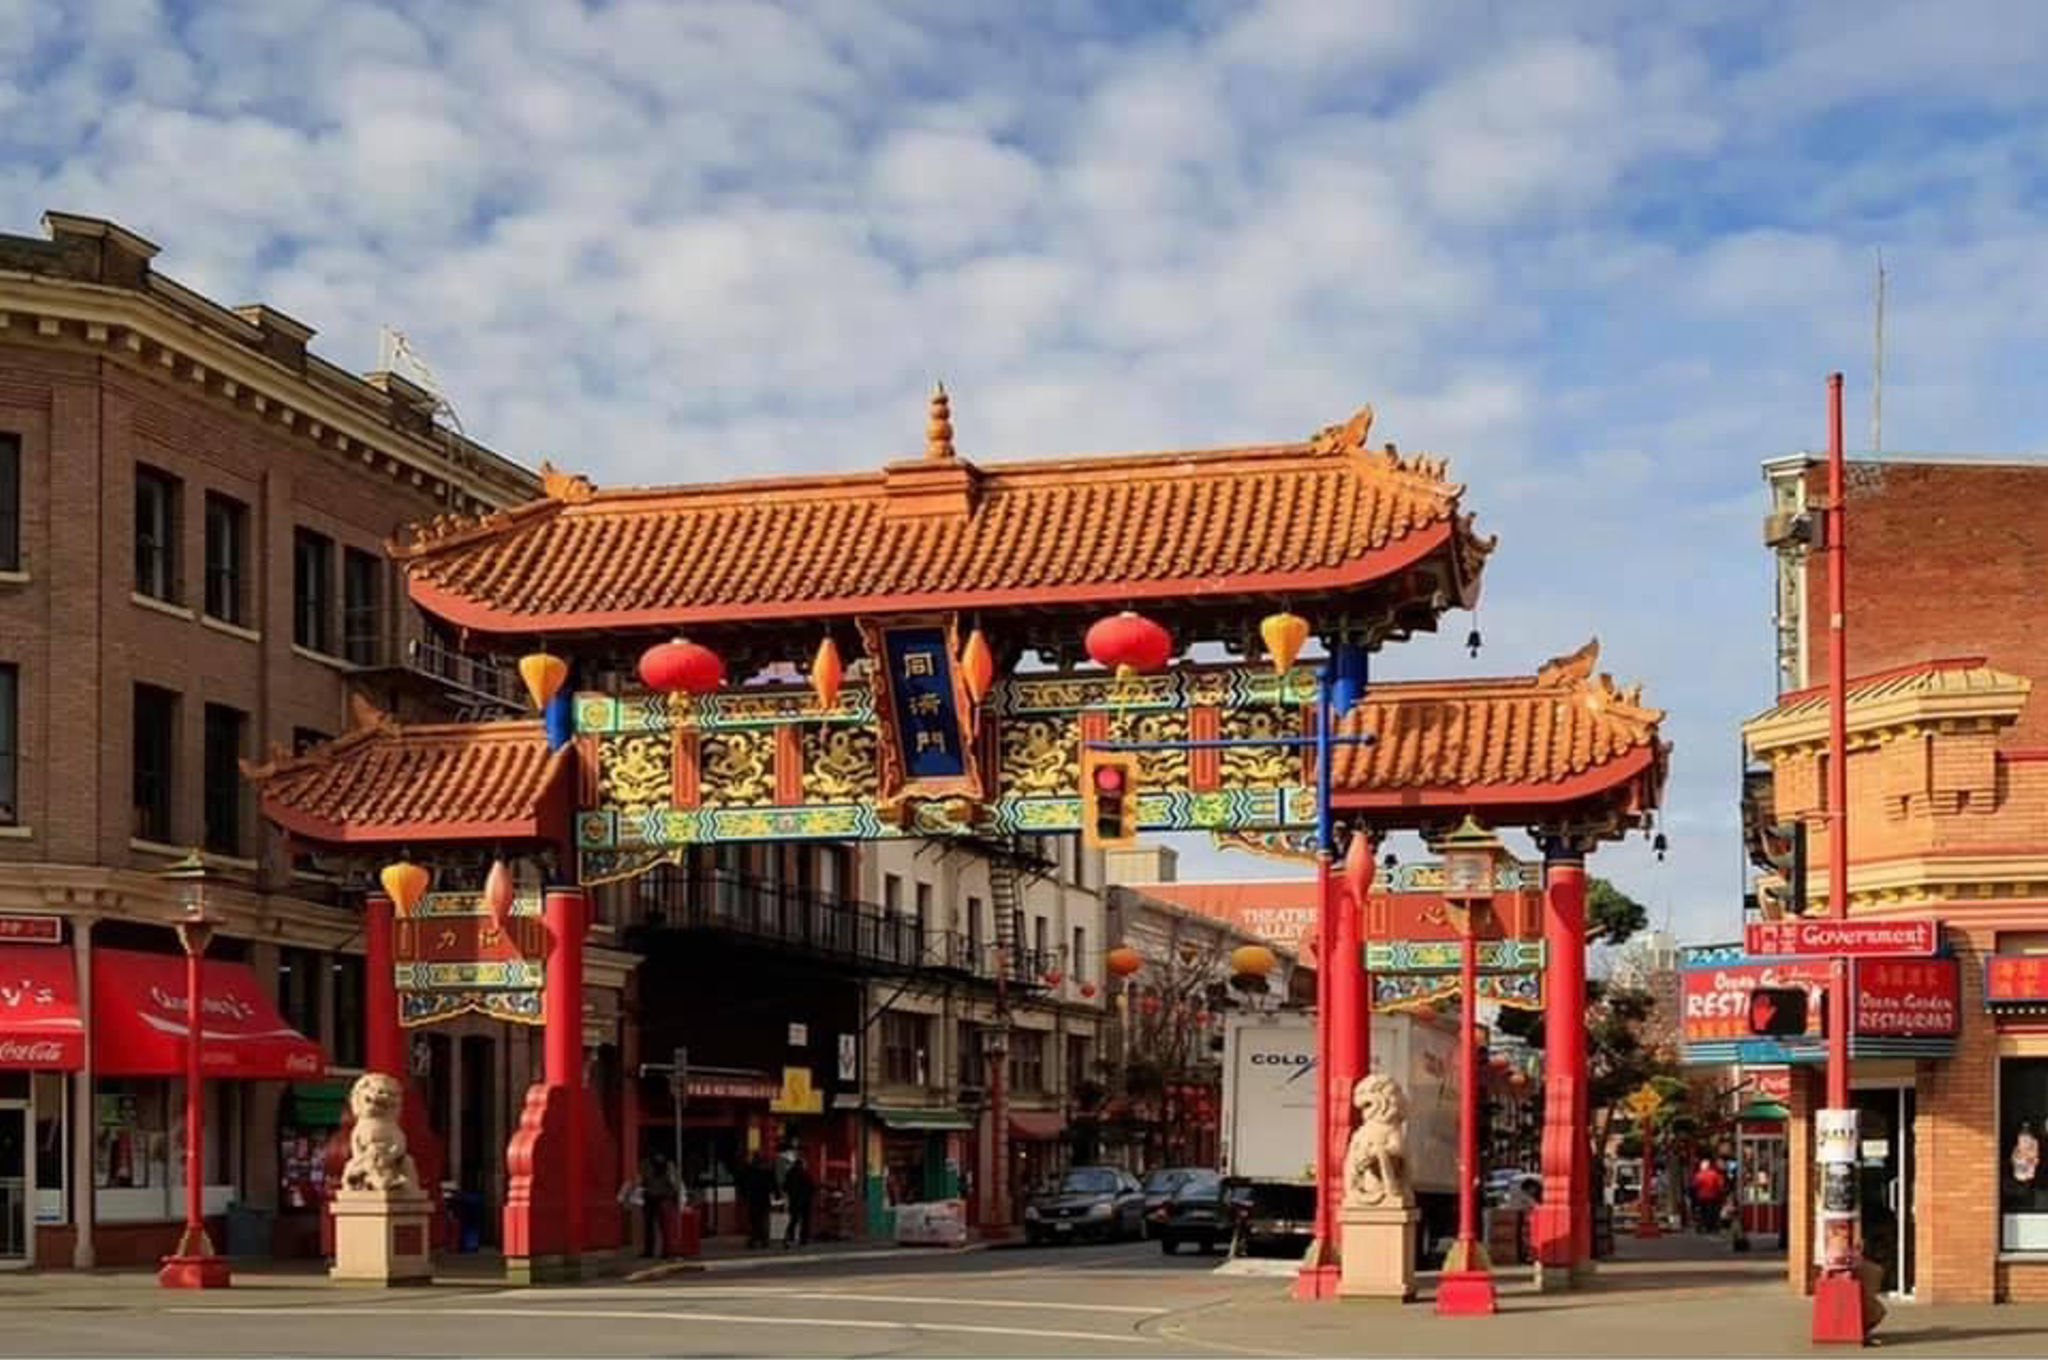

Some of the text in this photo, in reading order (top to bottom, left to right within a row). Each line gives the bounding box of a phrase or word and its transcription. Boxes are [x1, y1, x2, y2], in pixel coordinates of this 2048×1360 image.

[1802, 925, 1926, 946] Government
[1859, 1012, 1953, 1029] RESTAURANT
[1252, 1053, 1308, 1065] COLD
